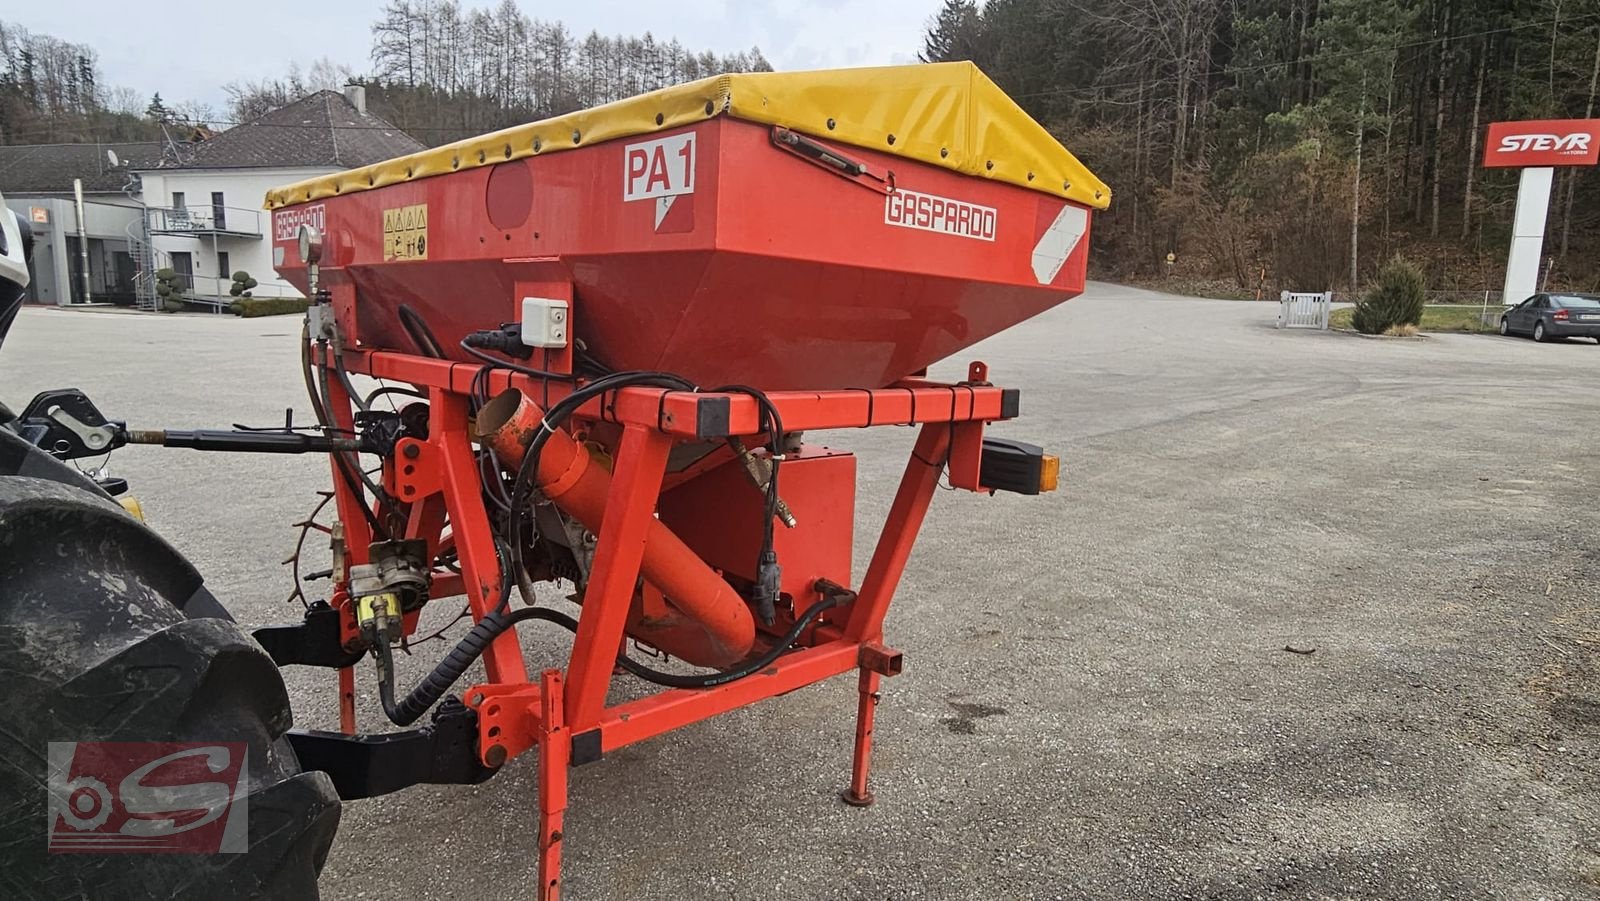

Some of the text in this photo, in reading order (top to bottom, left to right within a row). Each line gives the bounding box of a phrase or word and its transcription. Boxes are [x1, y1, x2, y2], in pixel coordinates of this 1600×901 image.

[1496, 133, 1591, 152] STEYR
[628, 140, 692, 195] PA 1
[888, 191, 995, 239] GASPARDO
